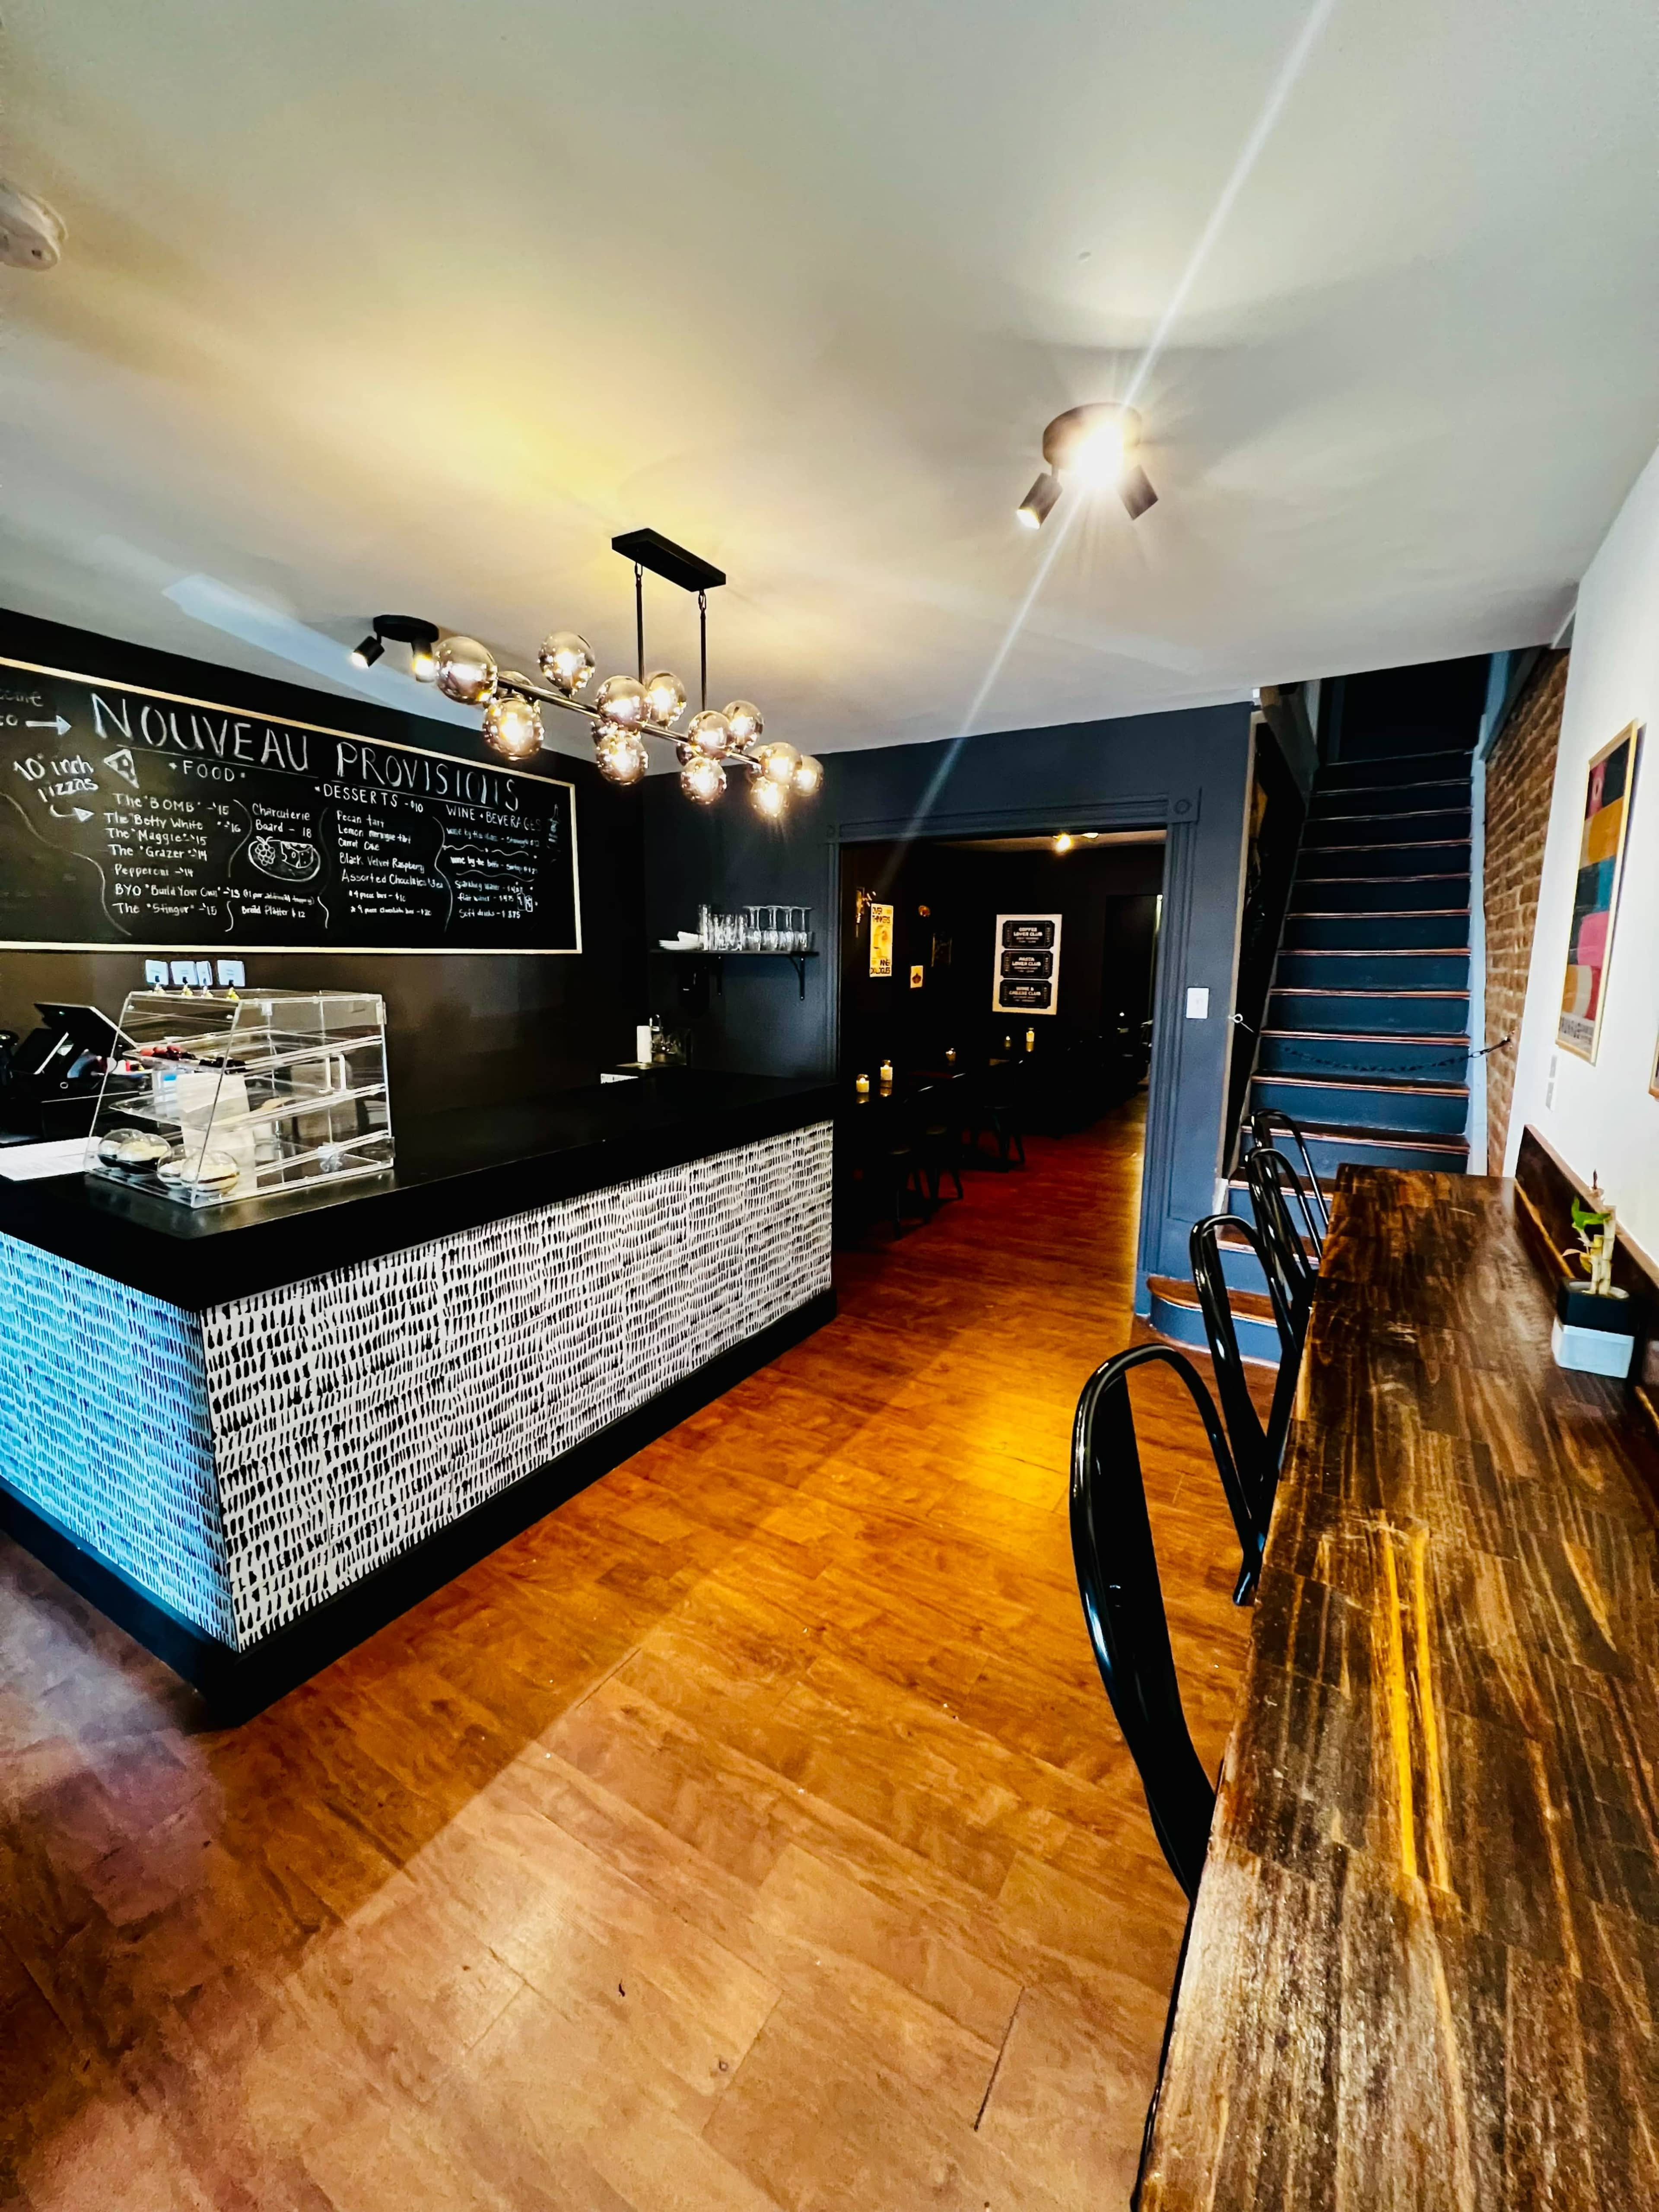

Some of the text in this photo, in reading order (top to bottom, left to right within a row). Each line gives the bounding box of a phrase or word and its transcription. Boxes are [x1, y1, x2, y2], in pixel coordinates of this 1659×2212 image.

[92, 693, 308, 771] NOUVEAU
[51, 755, 94, 776] inch
[183, 760, 235, 782] FOOD
[112, 793, 142, 807] The
[324, 783, 398, 807] DESSERTS
[252, 802, 310, 821] Charcuterie
[337, 810, 362, 823] Pecan
[445, 804, 476, 821] WINE
[103, 811, 129, 824] The
[170, 817, 203, 831] White
[256, 819, 283, 832] Board
[303, 827, 312, 838] 18
[105, 828, 129, 839] The
[338, 824, 364, 837] Lemon
[108, 844, 133, 856] The
[340, 852, 364, 865] Black
[368, 855, 389, 867] Velvet
[114, 863, 169, 877] Pepperoni
[341, 868, 387, 883] Assorted
[114, 883, 142, 896] BYO
[178, 884, 197, 896] Your
[112, 903, 140, 914] The
